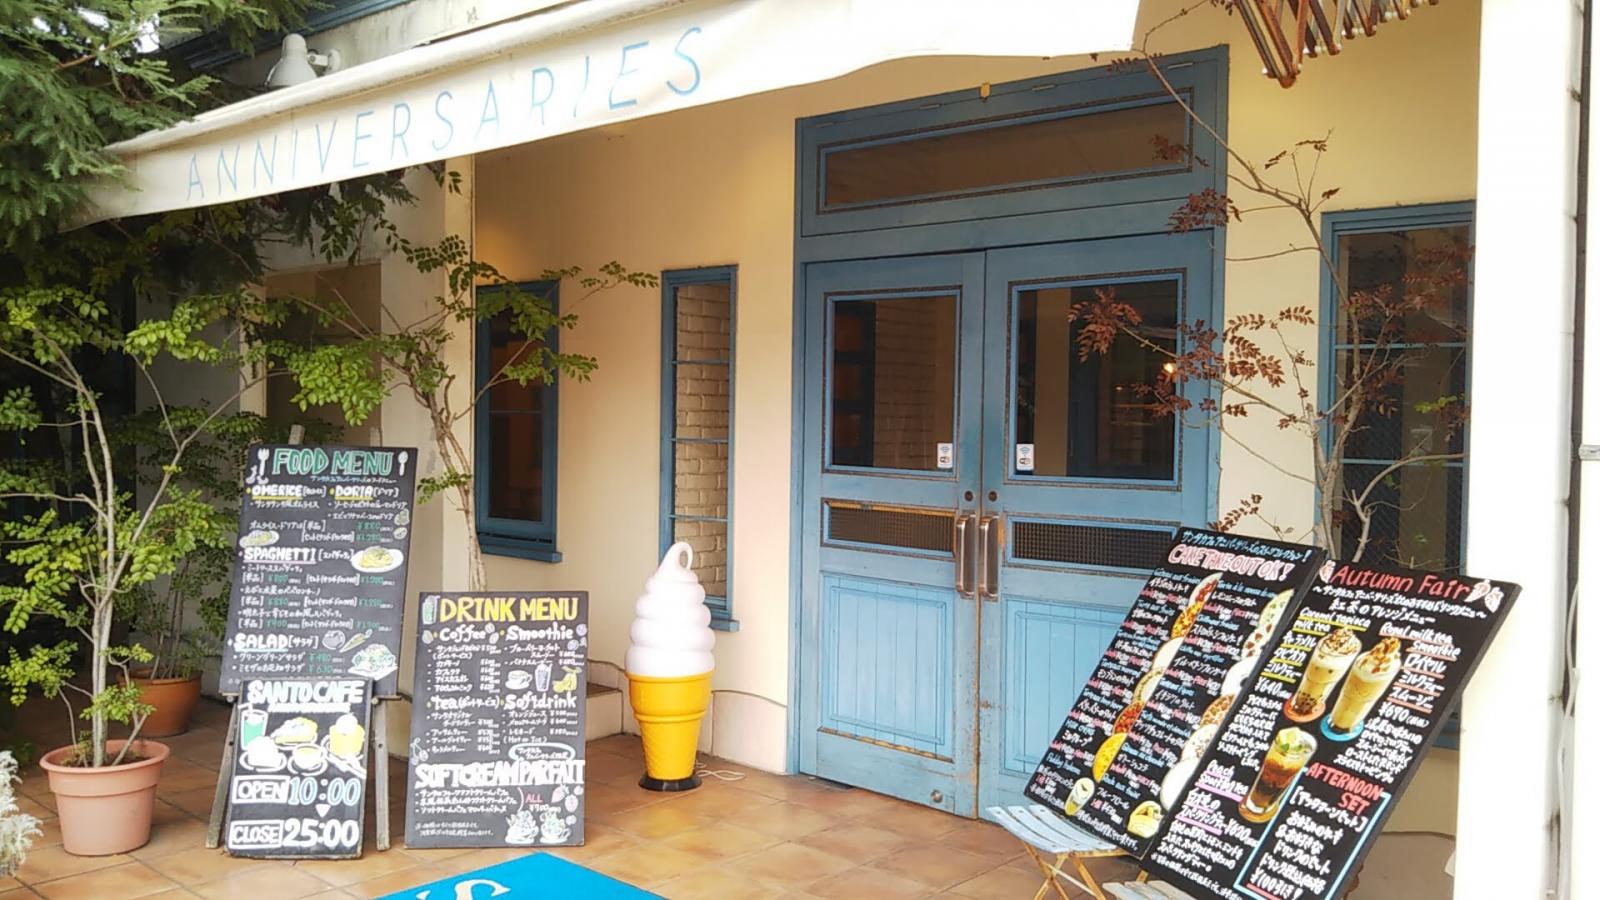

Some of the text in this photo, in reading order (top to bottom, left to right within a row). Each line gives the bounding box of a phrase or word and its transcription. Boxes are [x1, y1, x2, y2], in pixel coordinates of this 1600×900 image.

[187, 26, 704, 201] ANNIVERSARIES
[272, 448, 394, 476] FOOD MENU
[335, 484, 373, 497] DORIA
[243, 547, 316, 561] SPAGHETTI
[1226, 555, 1265, 576] OUT
[1257, 560, 1295, 581] OK!
[1330, 566, 1470, 602] Autumn Fair
[439, 597, 579, 622] DRINK MENU
[1300, 607, 1371, 628] Caramel tapioca
[439, 624, 487, 642] Coffee
[505, 622, 574, 641] Smoothie
[1293, 618, 1333, 633] milk tea
[1379, 622, 1452, 646] Royal milk tea
[234, 632, 288, 649] SALAD
[1283, 630, 1316, 649] キャラメル
[1409, 638, 1461, 659] Smoothie
[1274, 645, 1308, 664] タピオカ
[1402, 652, 1452, 674] ロイヤル
[1255, 676, 1282, 696] ¥640
[1397, 670, 1445, 690] ミルクティー
[1387, 686, 1440, 709] スムージー
[1378, 702, 1409, 722] ¥690
[516, 760, 586, 786] PARFAIT
[1205, 760, 1235, 779] Peach
[238, 776, 361, 806] OPEN 10:00
[1306, 763, 1389, 800] AFTERNOON
[526, 794, 543, 803] ALL
[1334, 792, 1374, 818] SET
[232, 818, 360, 848] CLOSE 25:00
[1221, 818, 1251, 842] ¥620
[1268, 840, 1330, 875] ドリンクのセット
